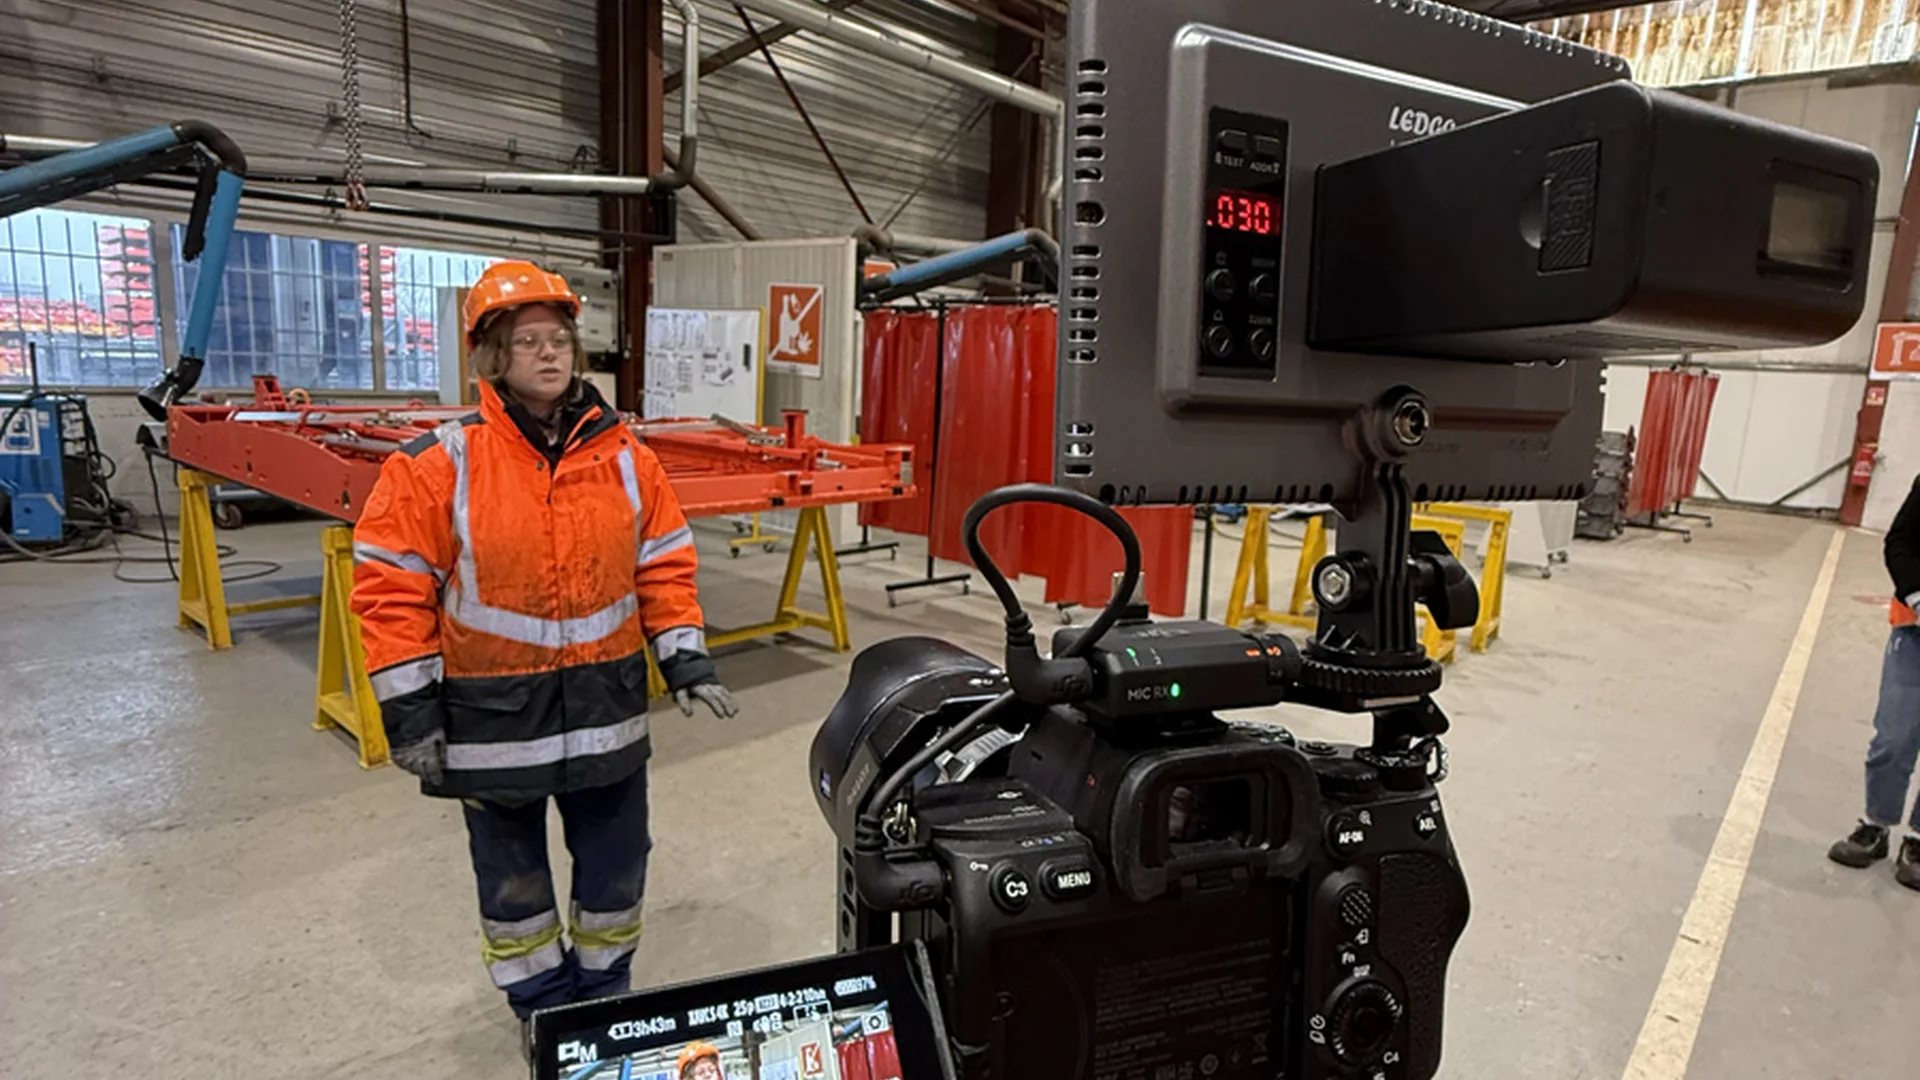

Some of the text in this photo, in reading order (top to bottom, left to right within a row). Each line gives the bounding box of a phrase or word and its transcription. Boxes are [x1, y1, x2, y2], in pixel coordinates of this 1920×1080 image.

[1127, 685, 1169, 701] MIC RX
[1005, 880, 1029, 898] C3
[1057, 871, 1092, 889] MENU
[632, 1015, 677, 1038] 3h43m
[732, 999, 755, 1017] 25p
[1383, 1051, 1400, 1065] C4
